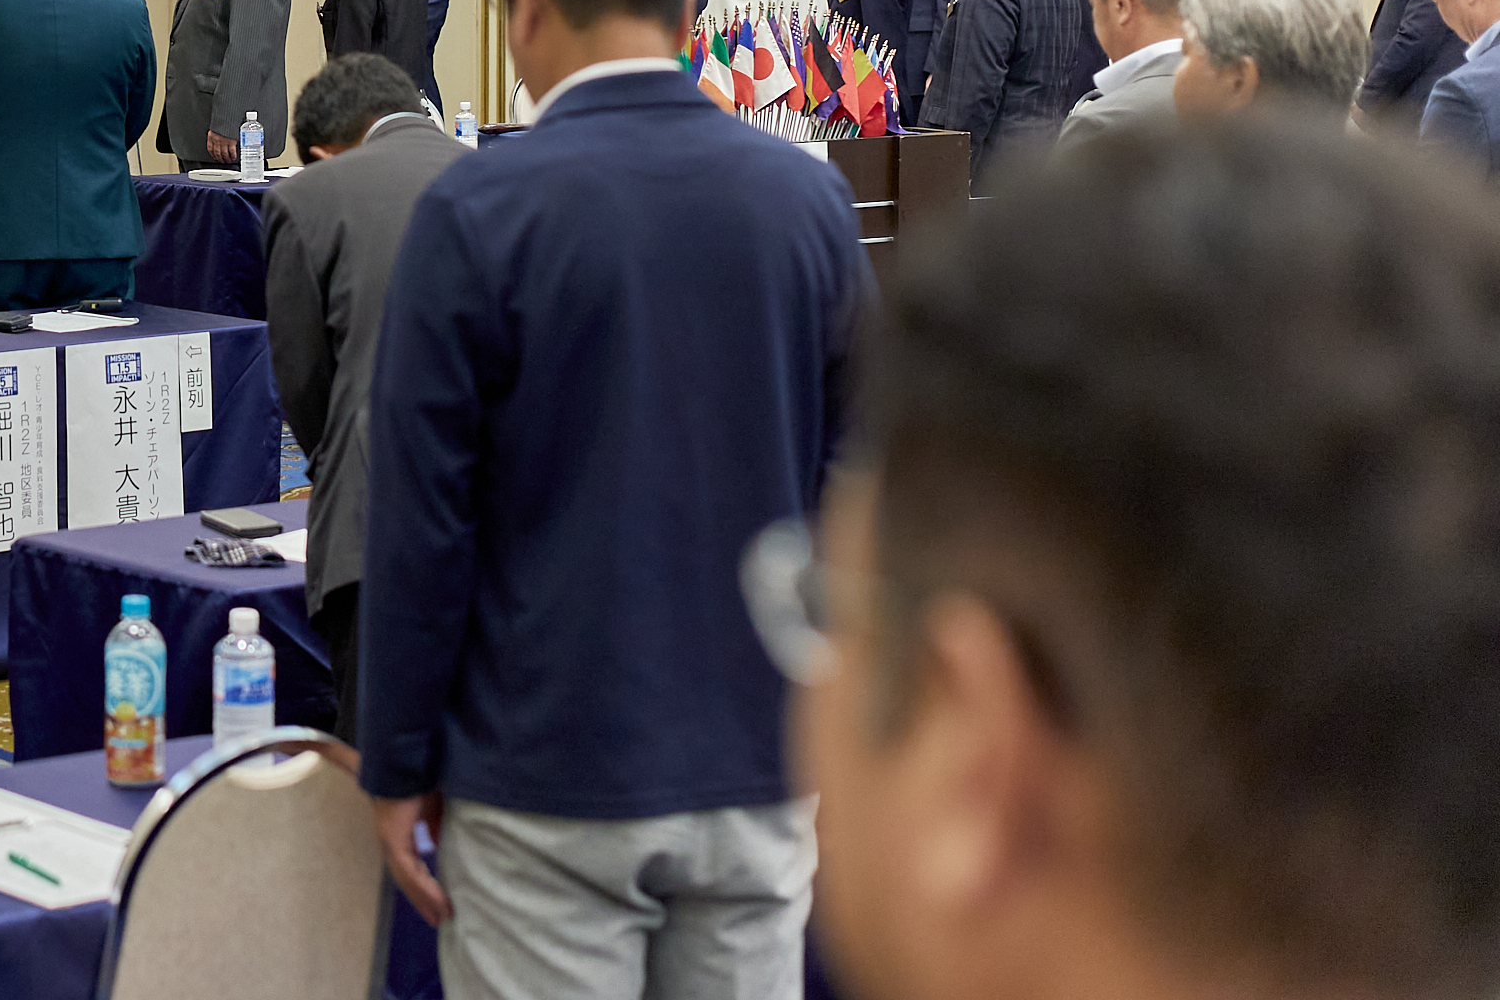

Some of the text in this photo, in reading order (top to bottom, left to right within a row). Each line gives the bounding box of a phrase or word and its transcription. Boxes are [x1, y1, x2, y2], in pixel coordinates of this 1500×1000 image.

[110, 353, 136, 363] MISSION
[117, 362, 130, 374] 1.5
[160, 371, 171, 425] 1R2Z
[186, 366, 205, 409] 前列
